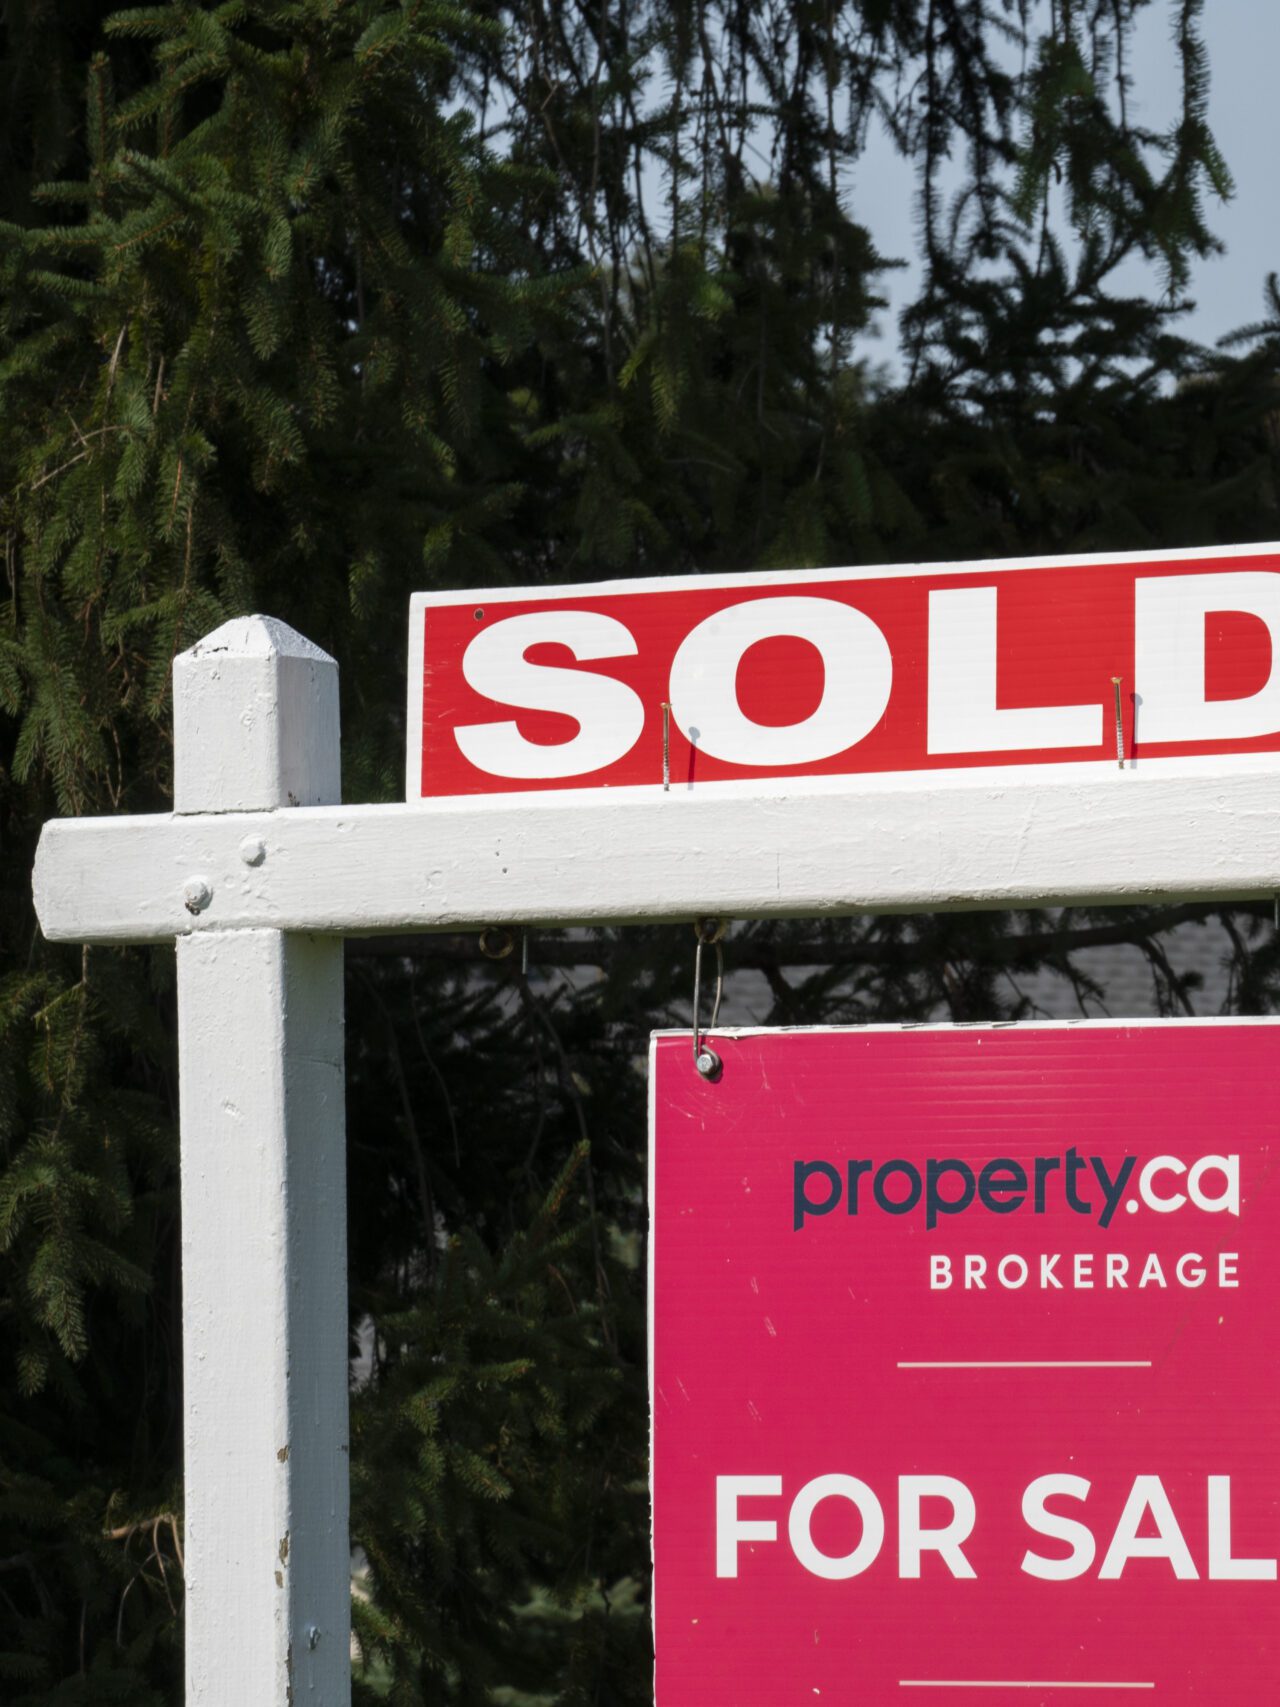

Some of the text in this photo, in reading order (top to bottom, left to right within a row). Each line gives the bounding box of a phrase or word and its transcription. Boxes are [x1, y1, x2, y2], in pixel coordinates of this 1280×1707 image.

[794, 1147, 1240, 1231] property.ca
[930, 1253, 1240, 1290] BROKERAGE
[715, 1474, 978, 1580] FOR
